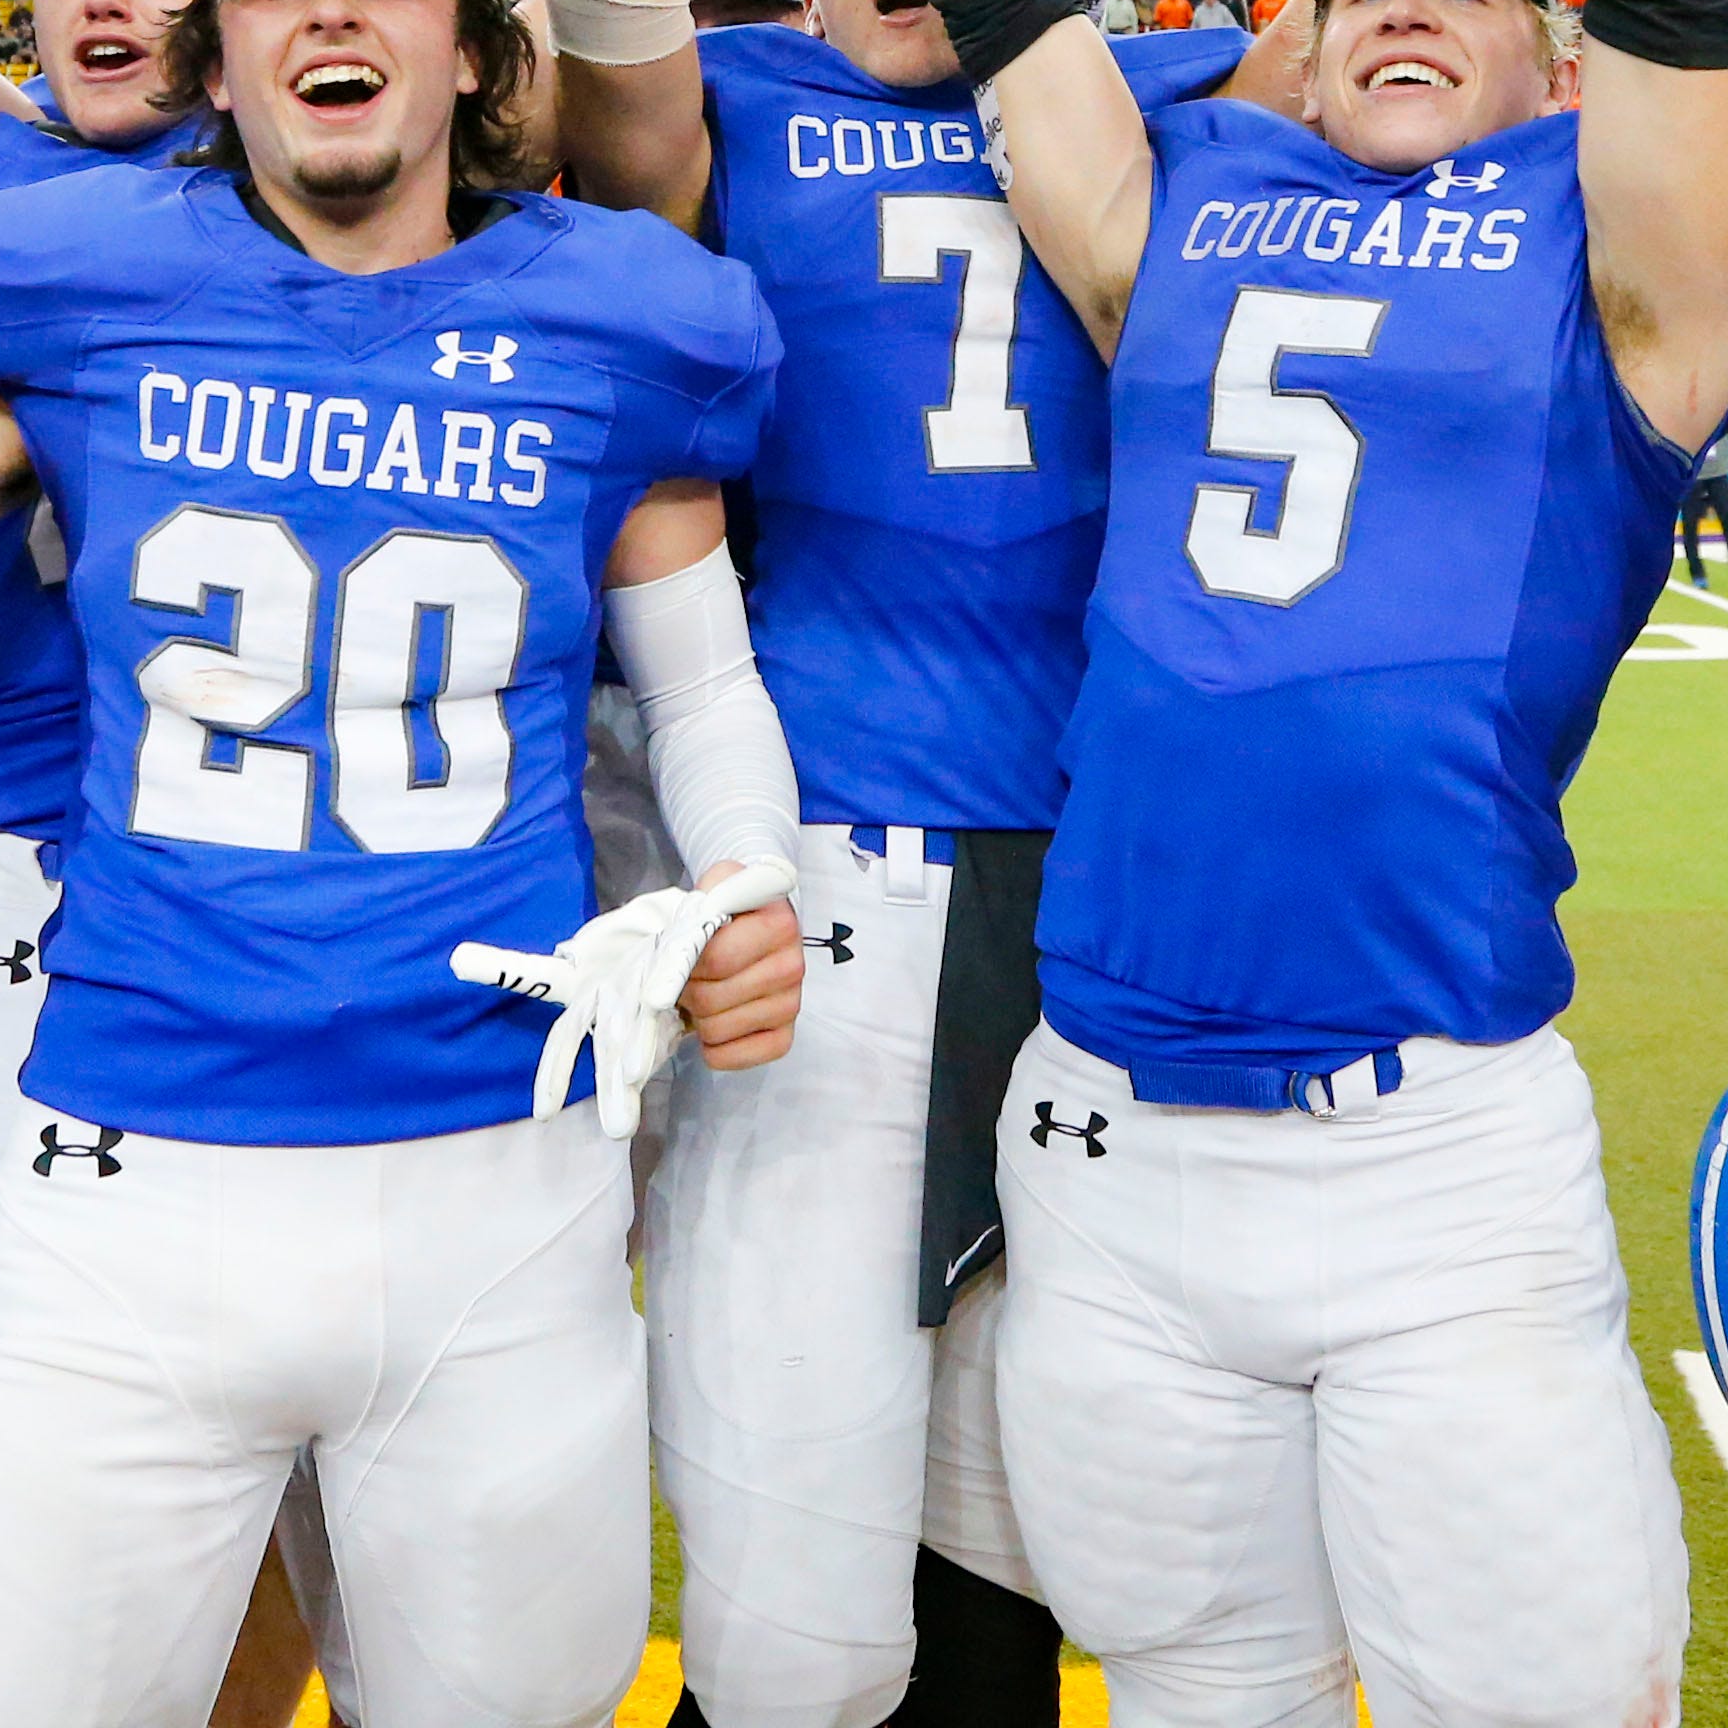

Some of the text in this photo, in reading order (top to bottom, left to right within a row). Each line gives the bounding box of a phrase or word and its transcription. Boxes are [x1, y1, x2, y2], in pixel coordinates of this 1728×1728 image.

[786, 113, 996, 180] COUG
[1180, 197, 1528, 272] COUGARS
[877, 192, 1038, 475] 7
[137, 370, 555, 509] COUGARS
[1183, 284, 1391, 609] 5
[128, 502, 531, 856] 20
